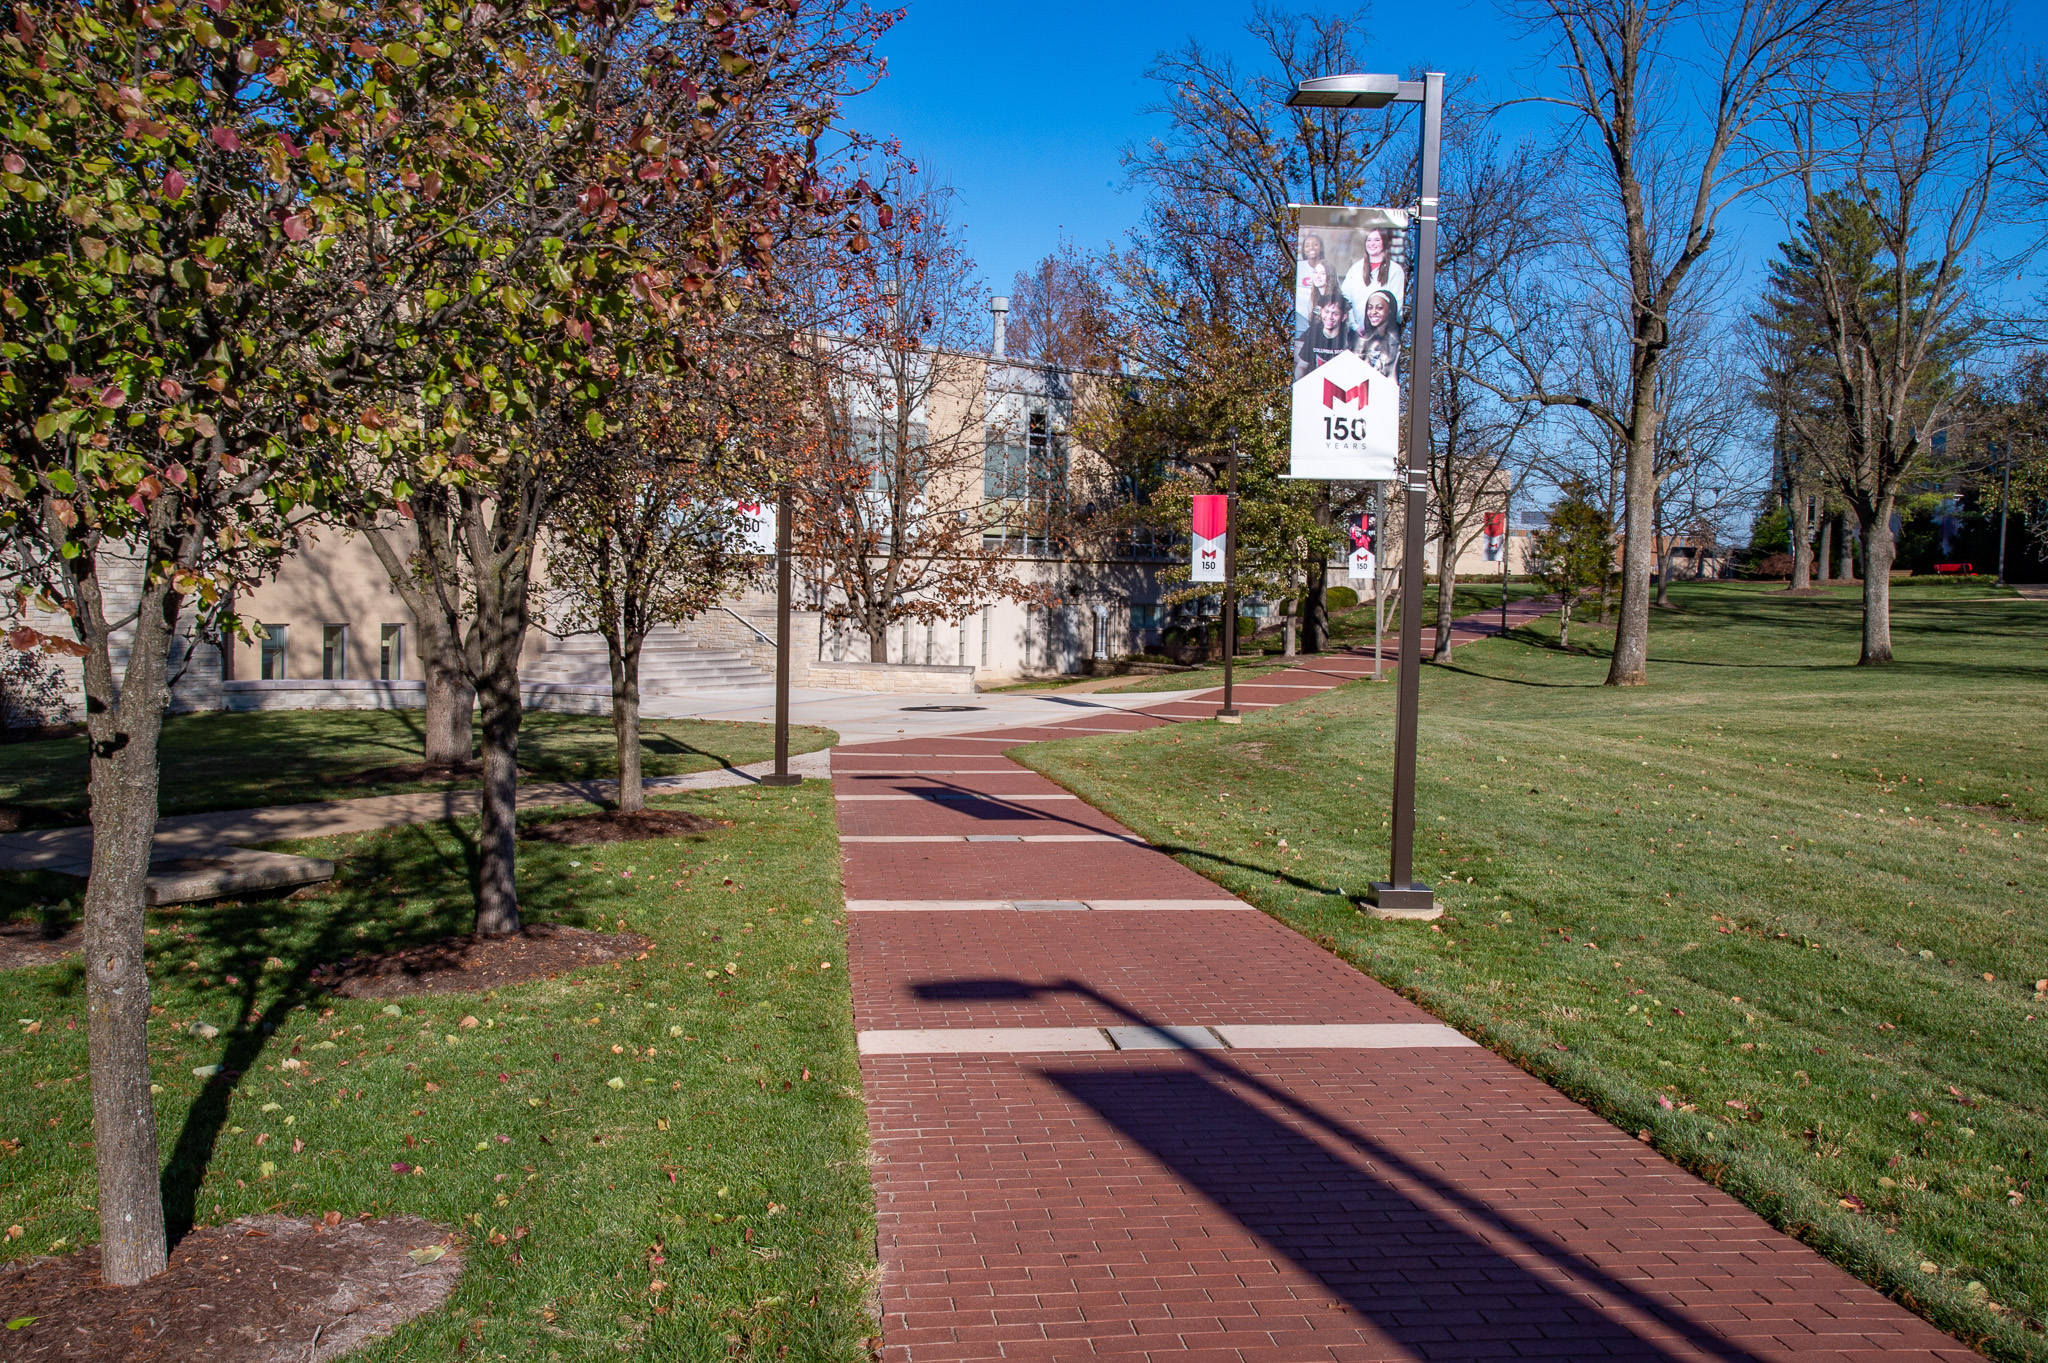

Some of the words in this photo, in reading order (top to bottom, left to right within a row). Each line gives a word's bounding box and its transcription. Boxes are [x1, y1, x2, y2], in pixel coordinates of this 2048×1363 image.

[1323, 377, 1369, 411] M
[1324, 416, 1367, 441] 150
[1326, 442, 1367, 450] YEARS
[1202, 549, 1216, 560] M
[1202, 561, 1216, 570] 150
